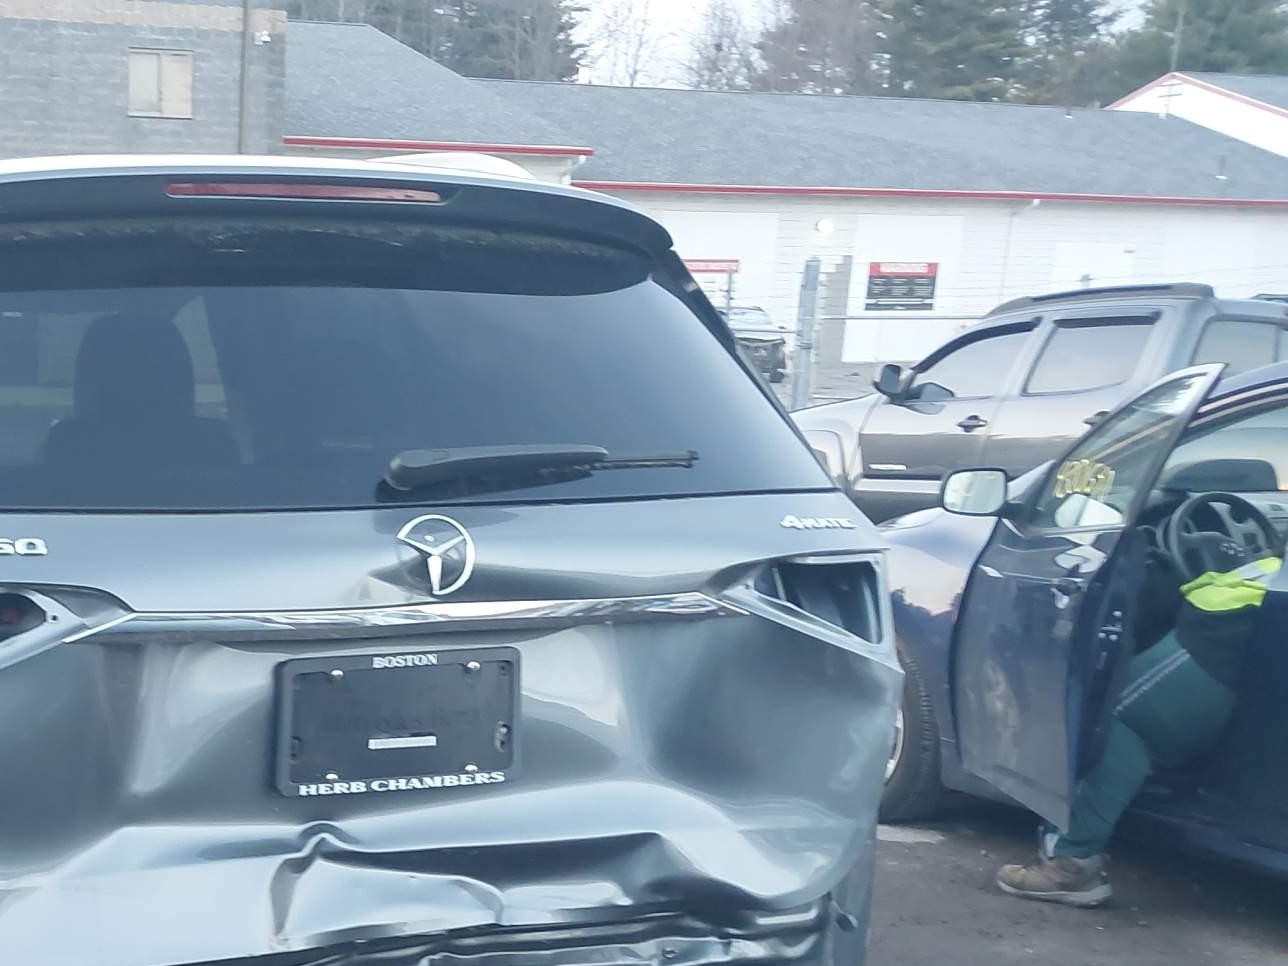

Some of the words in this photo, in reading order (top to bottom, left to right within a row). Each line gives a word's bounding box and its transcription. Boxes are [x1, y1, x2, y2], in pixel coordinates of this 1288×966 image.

[371, 653, 439, 669] BOSTON
[298, 782, 367, 797] HERB
[370, 771, 506, 792] CHAMBERS
